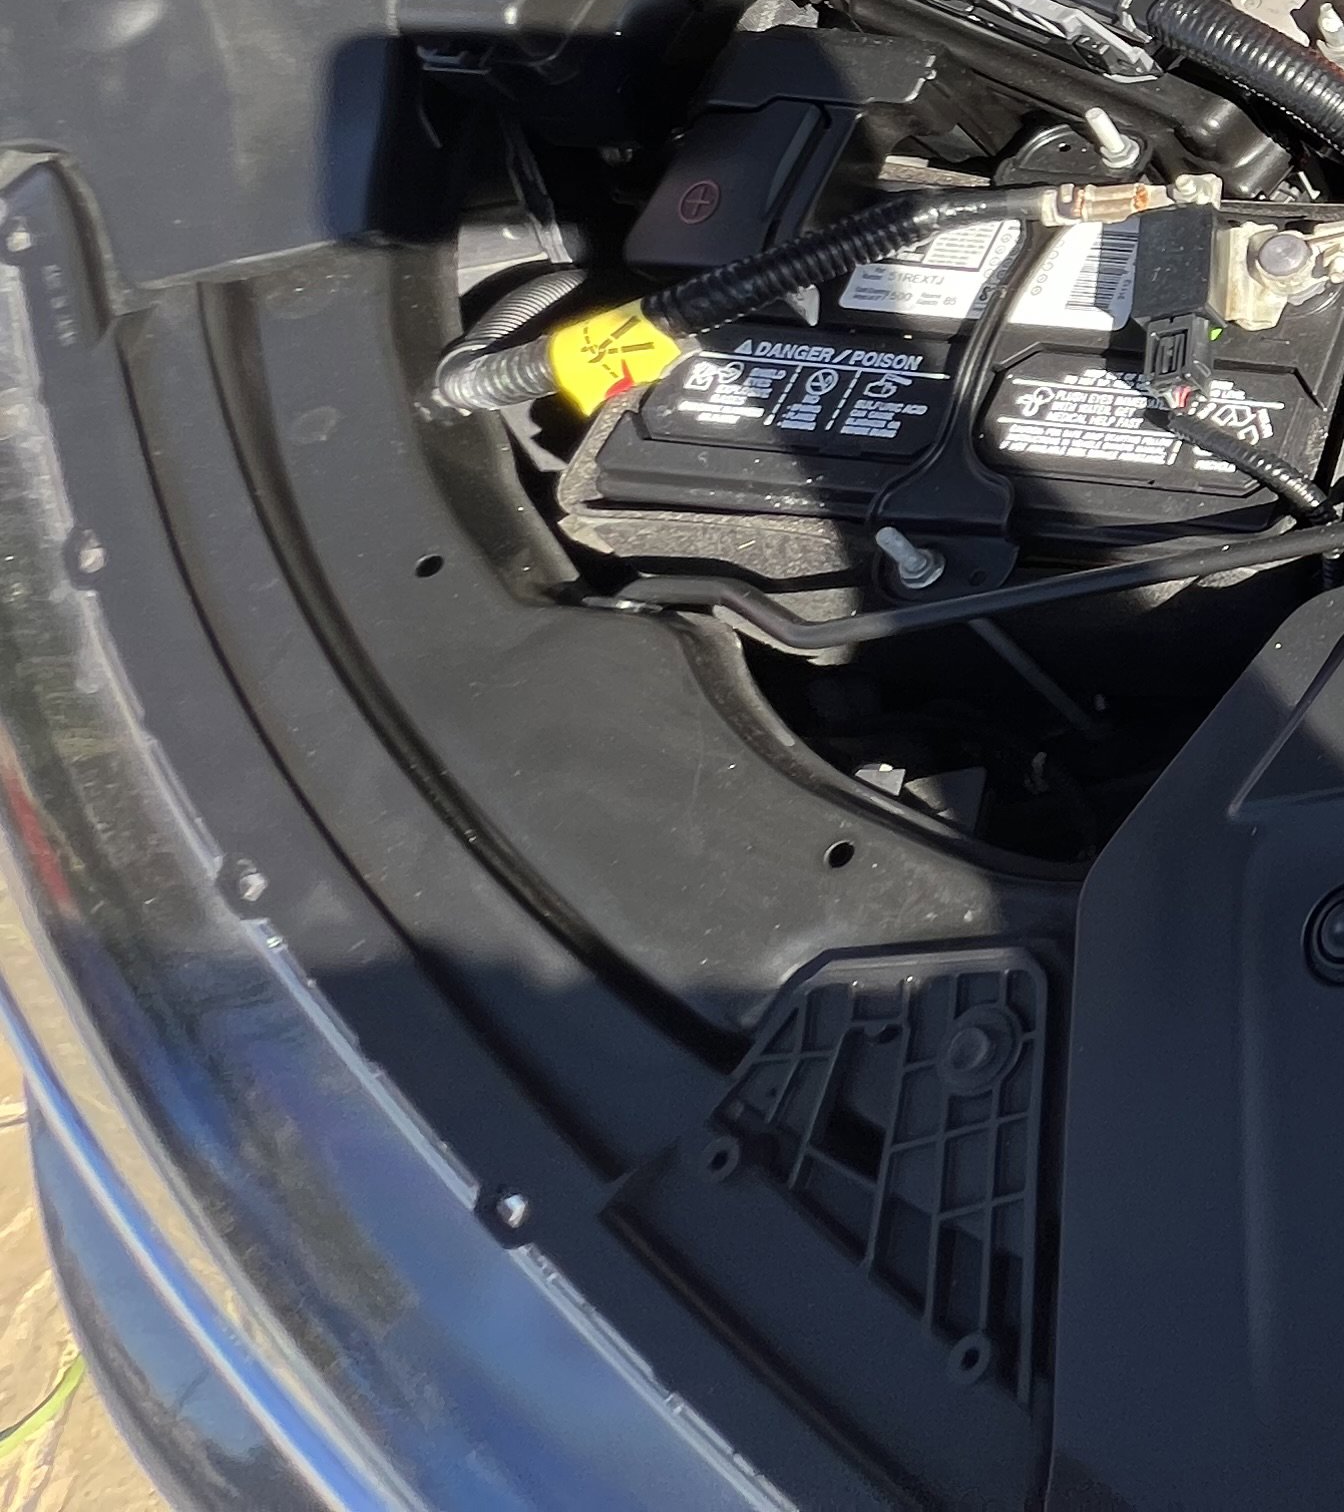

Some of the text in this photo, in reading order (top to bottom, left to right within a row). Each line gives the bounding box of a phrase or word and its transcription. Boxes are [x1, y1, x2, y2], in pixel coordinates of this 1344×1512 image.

[1087, 394, 1114, 406] EYES
[1046, 411, 1088, 426] MEDICAL
[1088, 415, 1117, 428] HELP
